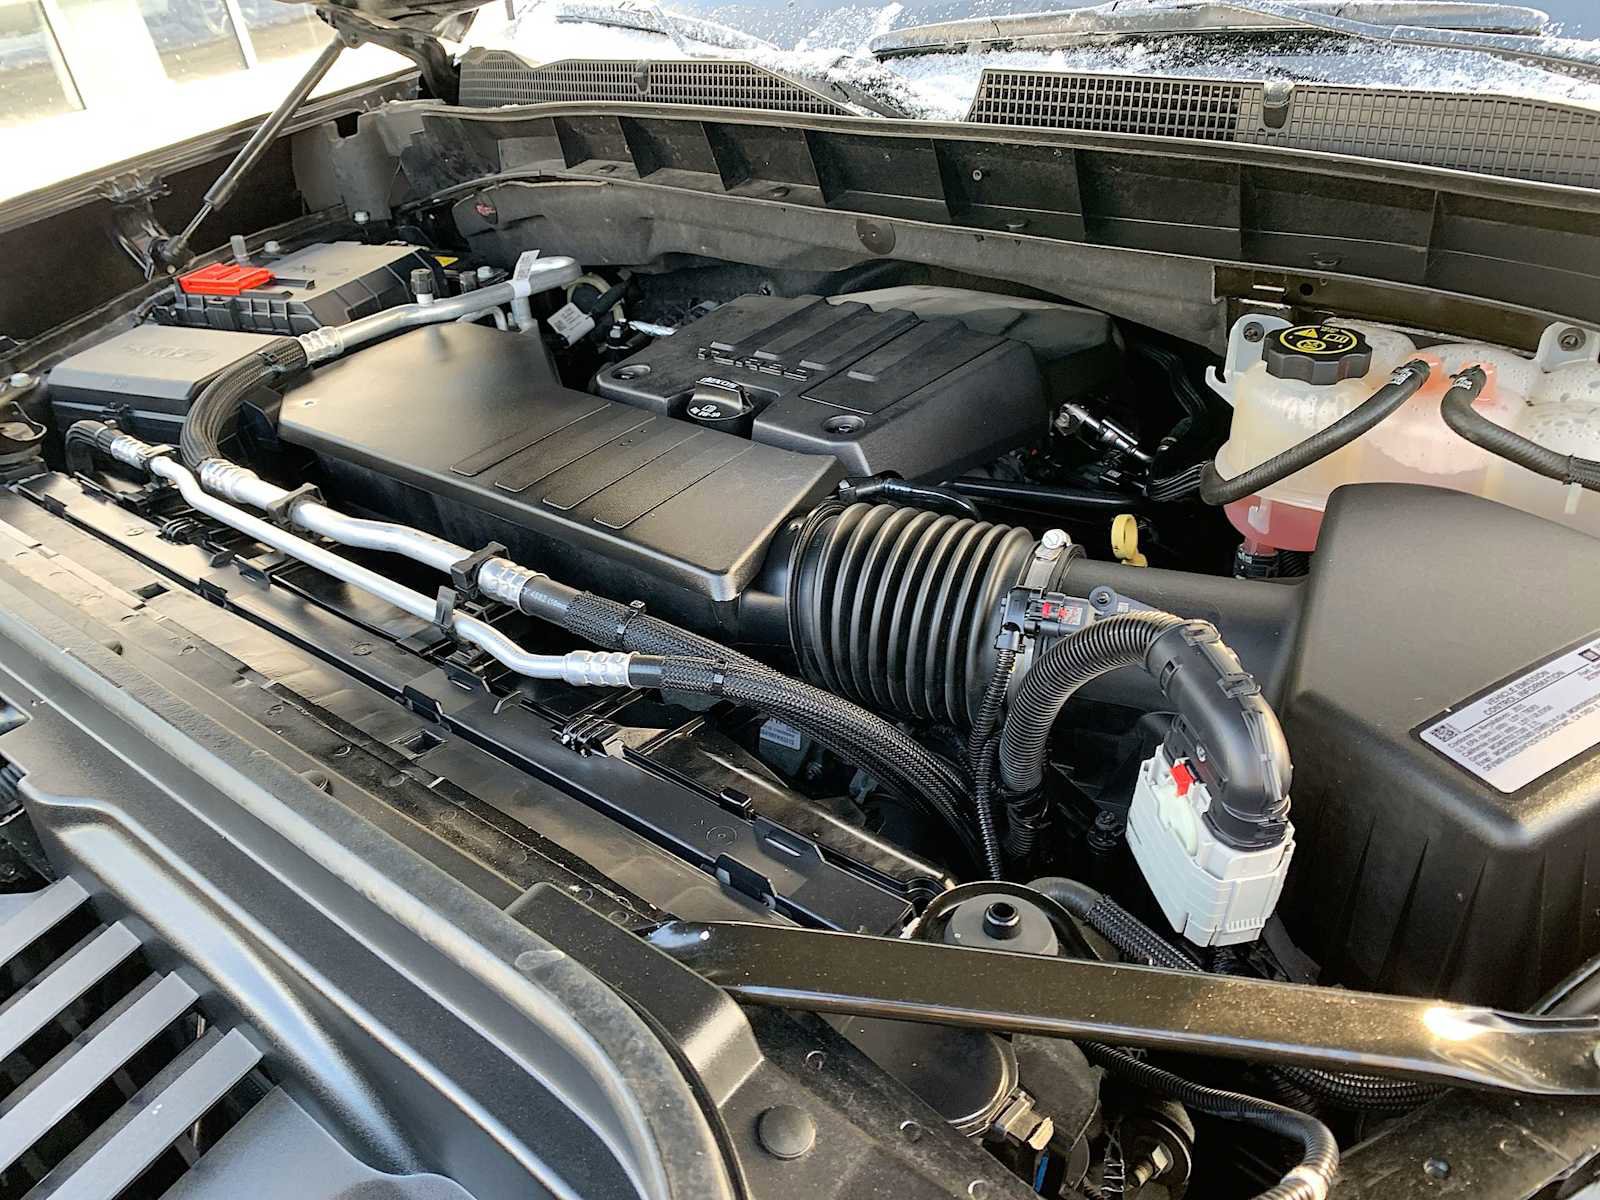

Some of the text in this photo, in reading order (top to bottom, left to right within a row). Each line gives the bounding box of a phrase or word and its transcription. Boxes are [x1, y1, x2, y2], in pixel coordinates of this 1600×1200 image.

[1483, 696, 1520, 716] CONTROL
[1518, 671, 1567, 697] INFORMATION
[1485, 670, 1551, 706] VEHICLE EMISSION
